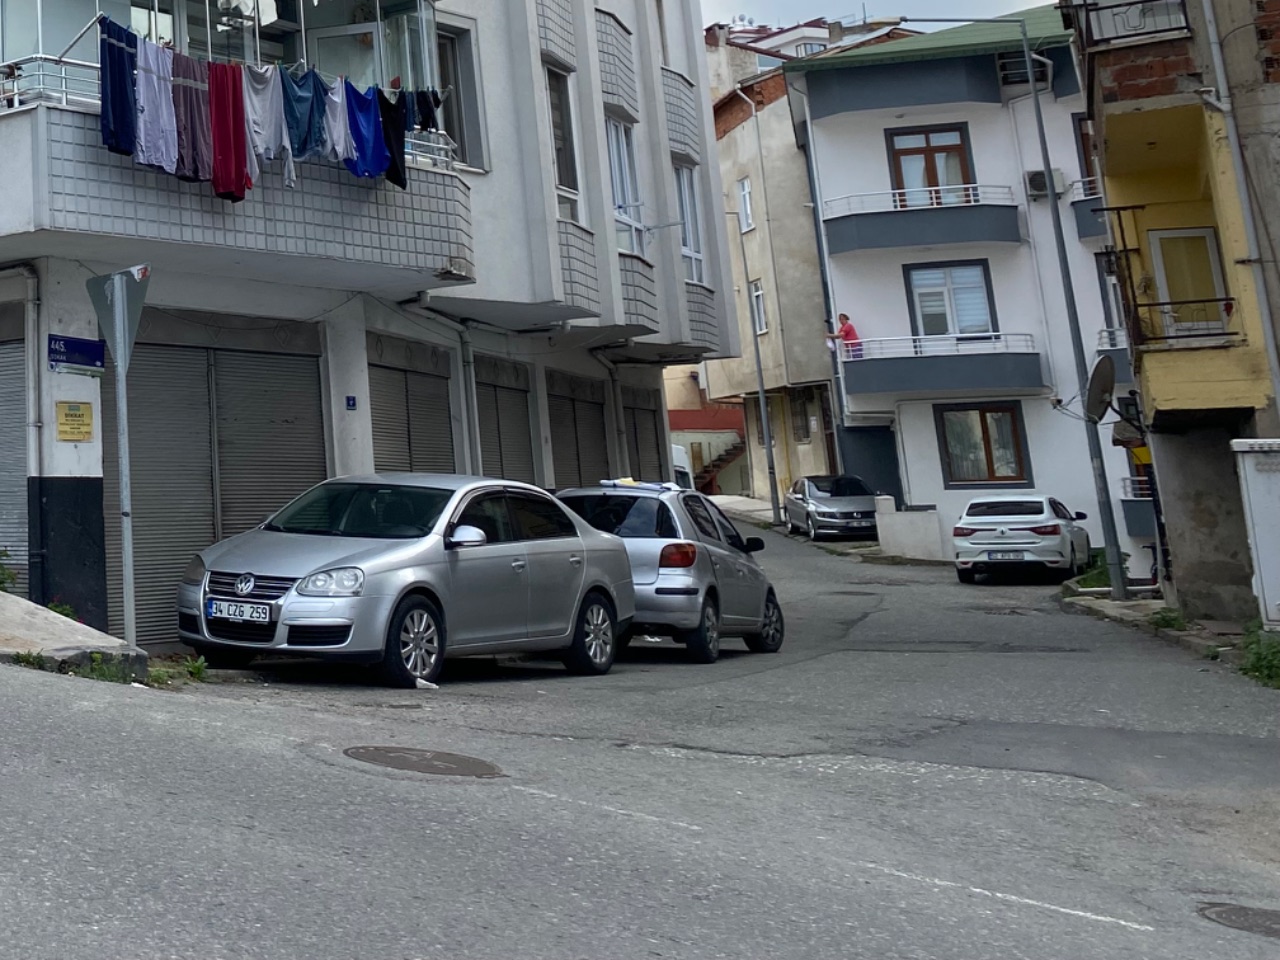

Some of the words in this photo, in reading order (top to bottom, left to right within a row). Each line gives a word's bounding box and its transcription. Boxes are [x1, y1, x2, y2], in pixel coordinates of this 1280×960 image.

[212, 602, 223, 616] 34
[227, 603, 245, 618] CZG
[249, 605, 268, 620] 259
